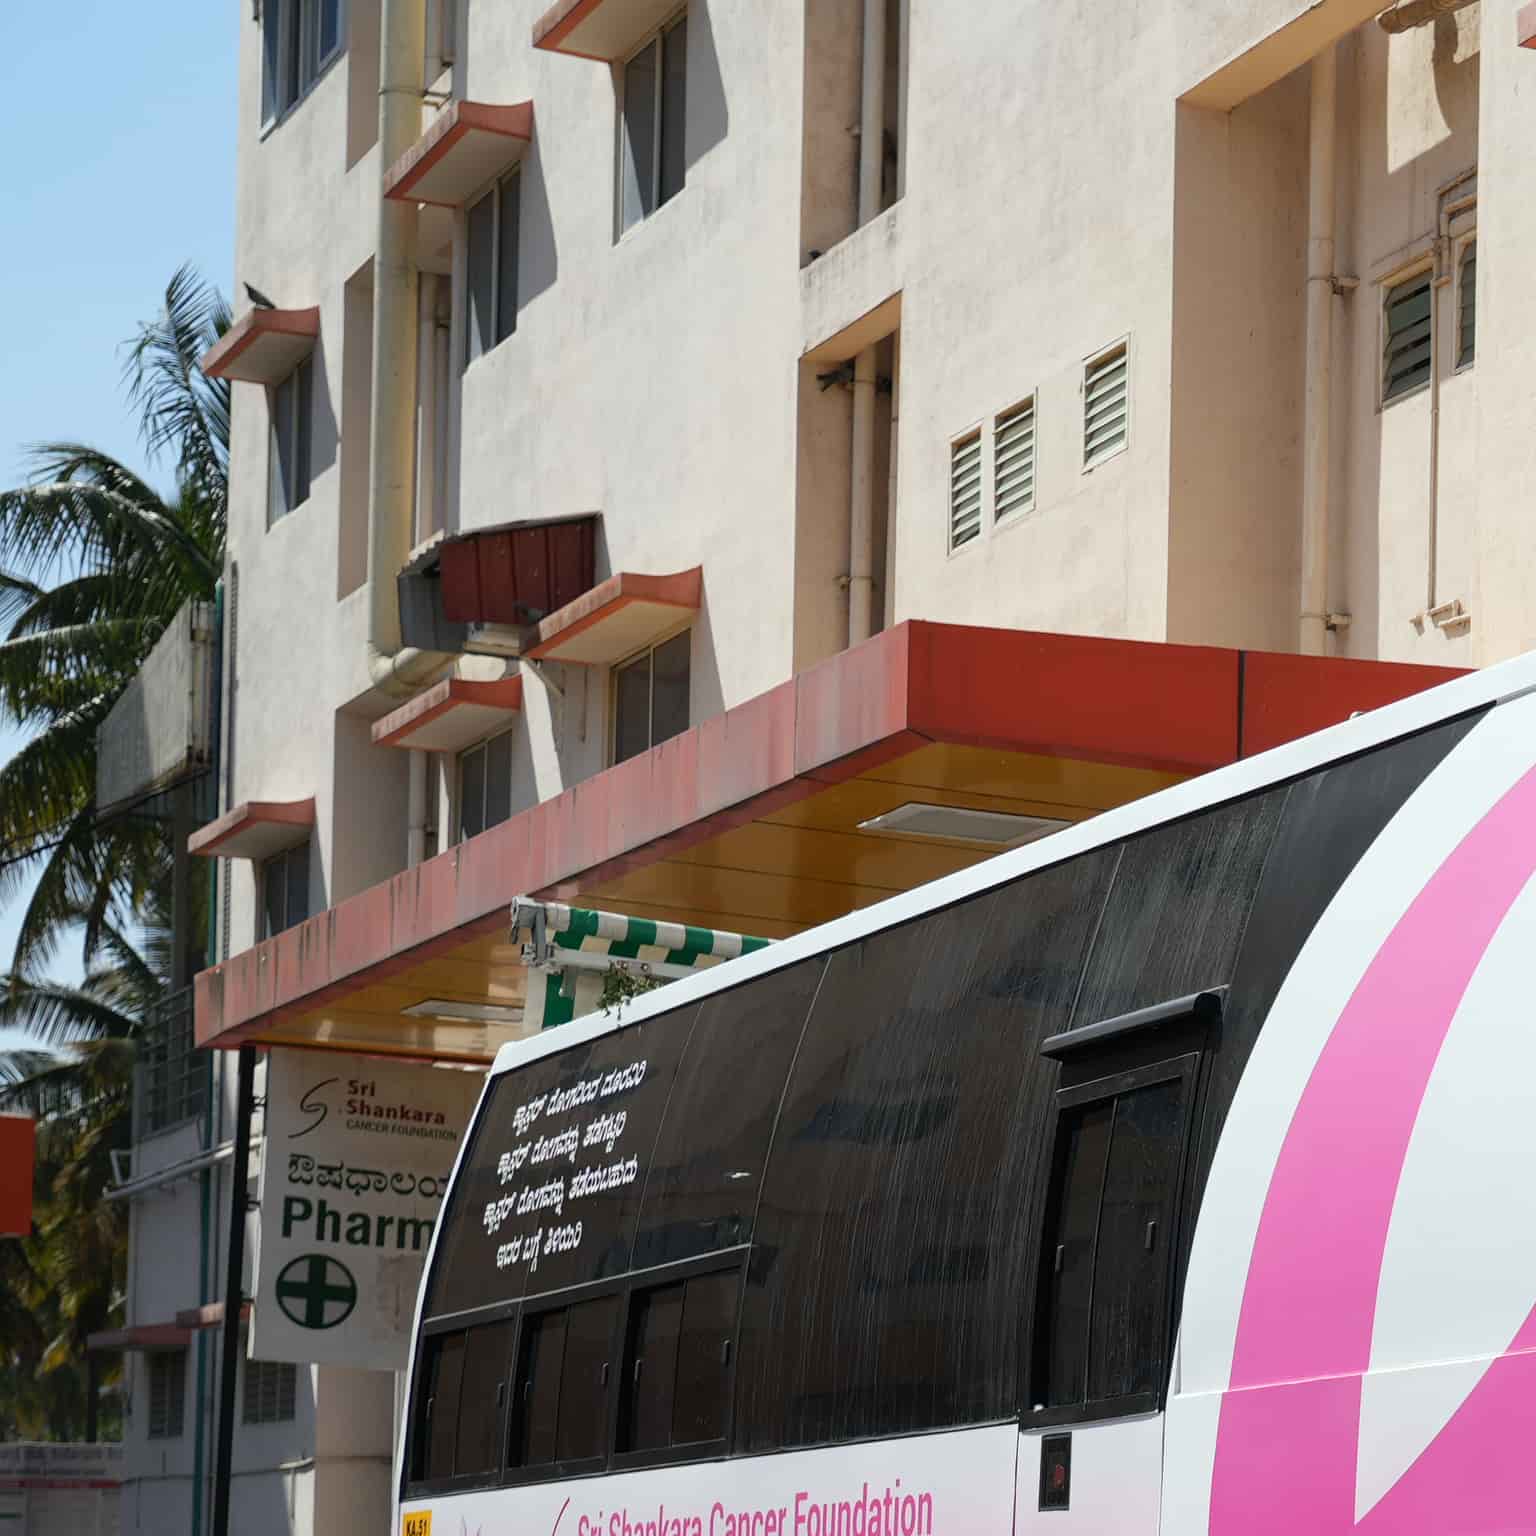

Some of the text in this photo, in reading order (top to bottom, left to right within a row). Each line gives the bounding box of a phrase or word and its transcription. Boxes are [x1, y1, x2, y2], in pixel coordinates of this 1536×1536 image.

[347, 1079, 376, 1096] Sri
[345, 1100, 446, 1125] Shankara
[345, 1119, 458, 1142] CANCER FOUNDATION
[406, 1519, 428, 1536] KA.51
